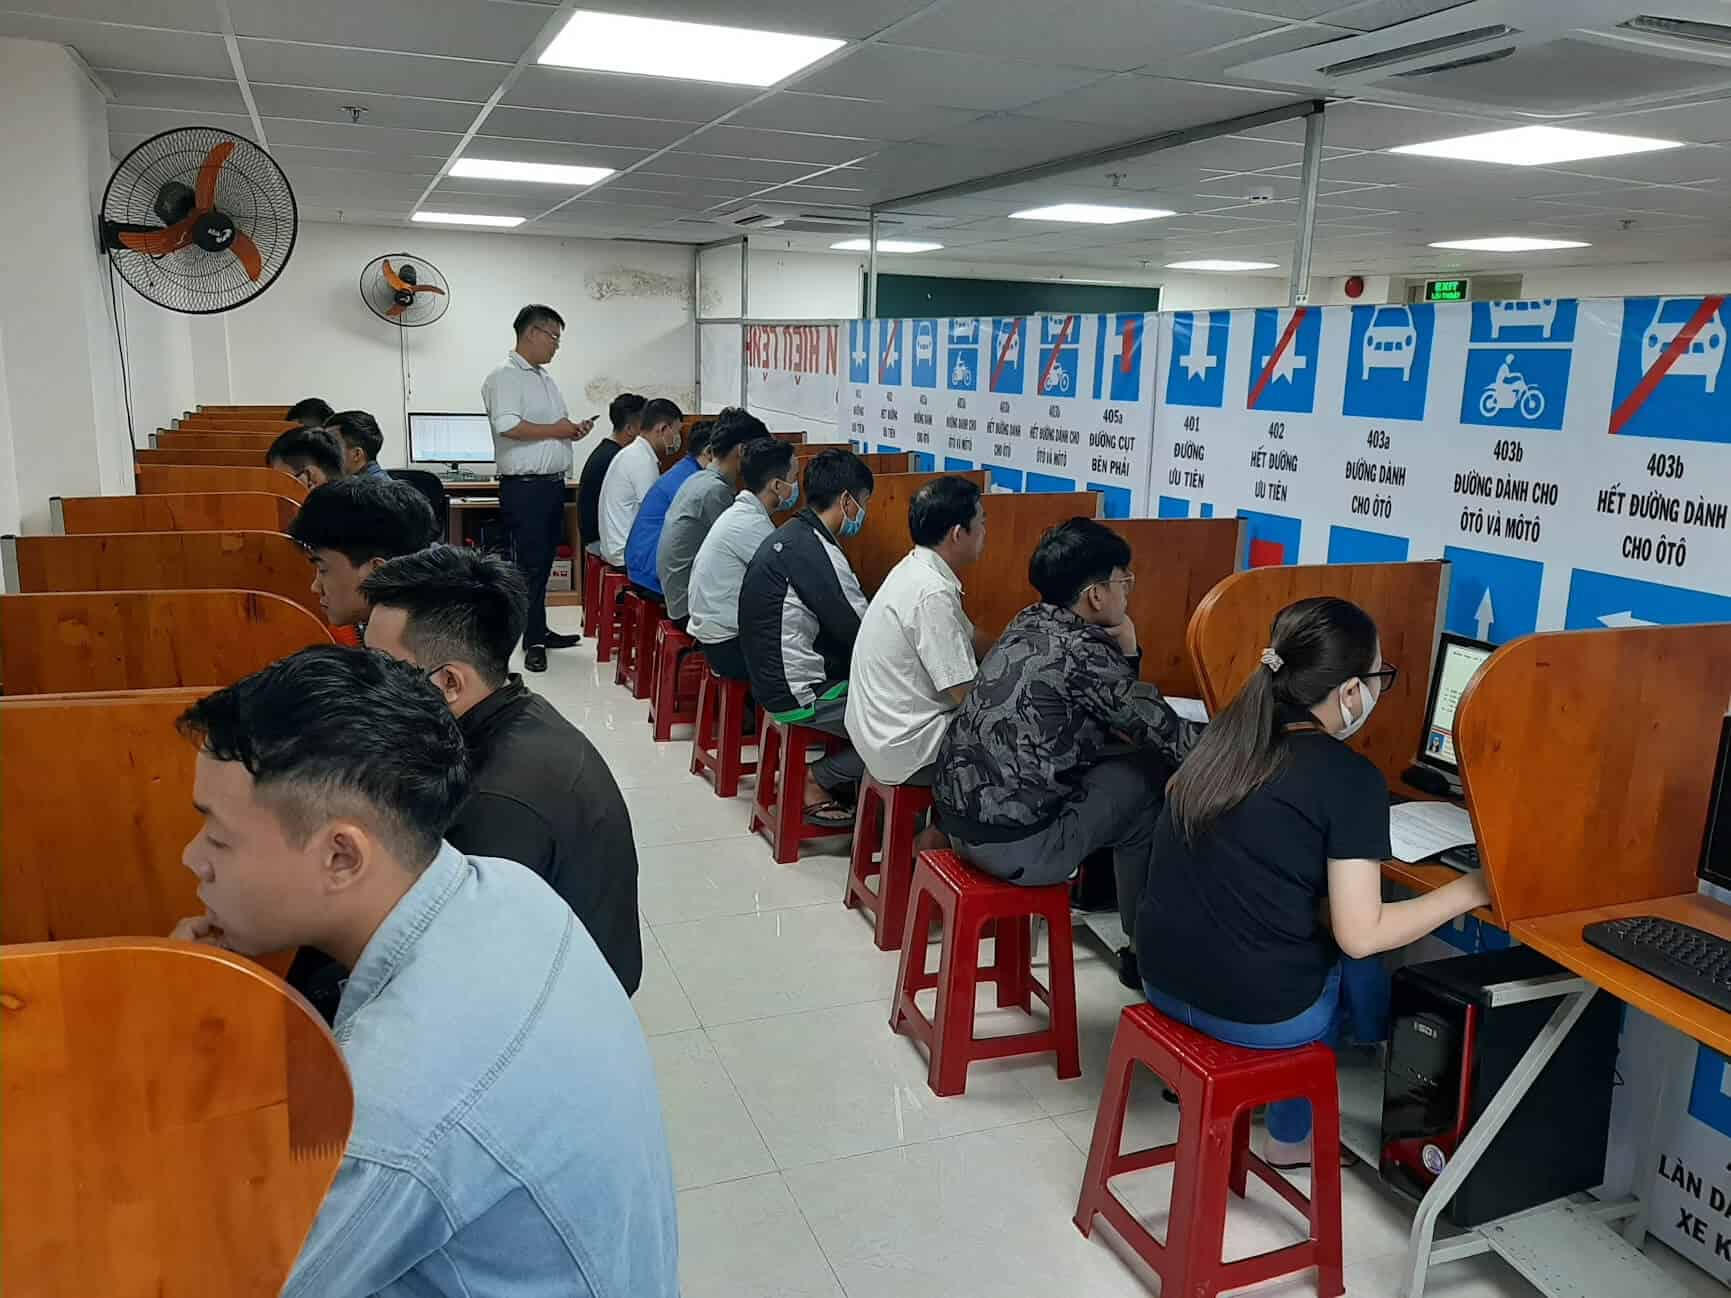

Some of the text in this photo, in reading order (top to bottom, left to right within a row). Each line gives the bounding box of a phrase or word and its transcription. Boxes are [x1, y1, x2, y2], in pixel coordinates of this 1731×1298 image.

[1435, 281, 1458, 291] EXIT
[1102, 408, 1123, 425] 405a
[1184, 416, 1200, 432] 401
[1268, 422, 1285, 439] 402
[1367, 429, 1391, 450] 403a
[1250, 445, 1267, 469] HẾT
[1493, 439, 1523, 463] 403b
[1091, 454, 1107, 473] BÊN
[1378, 460, 1406, 487] DÀNH
[1646, 453, 1684, 479] 403b
[1184, 468, 1204, 489] TIÊN
[1454, 468, 1558, 505] ĐƯỜNG DÀNH CHO
[1268, 480, 1287, 502] TIÊN
[1352, 494, 1392, 519] CHO ÔTÔ
[1597, 482, 1729, 529] HẾT ĐƯỜNG DÀNH
[1460, 506, 1541, 543] ÔTÔ VÀ MÔTÔ
[1622, 534, 1687, 567] CHO ÔTÔ
[1657, 1153, 1703, 1199] LÀN
[1676, 1207, 1709, 1244] XE
